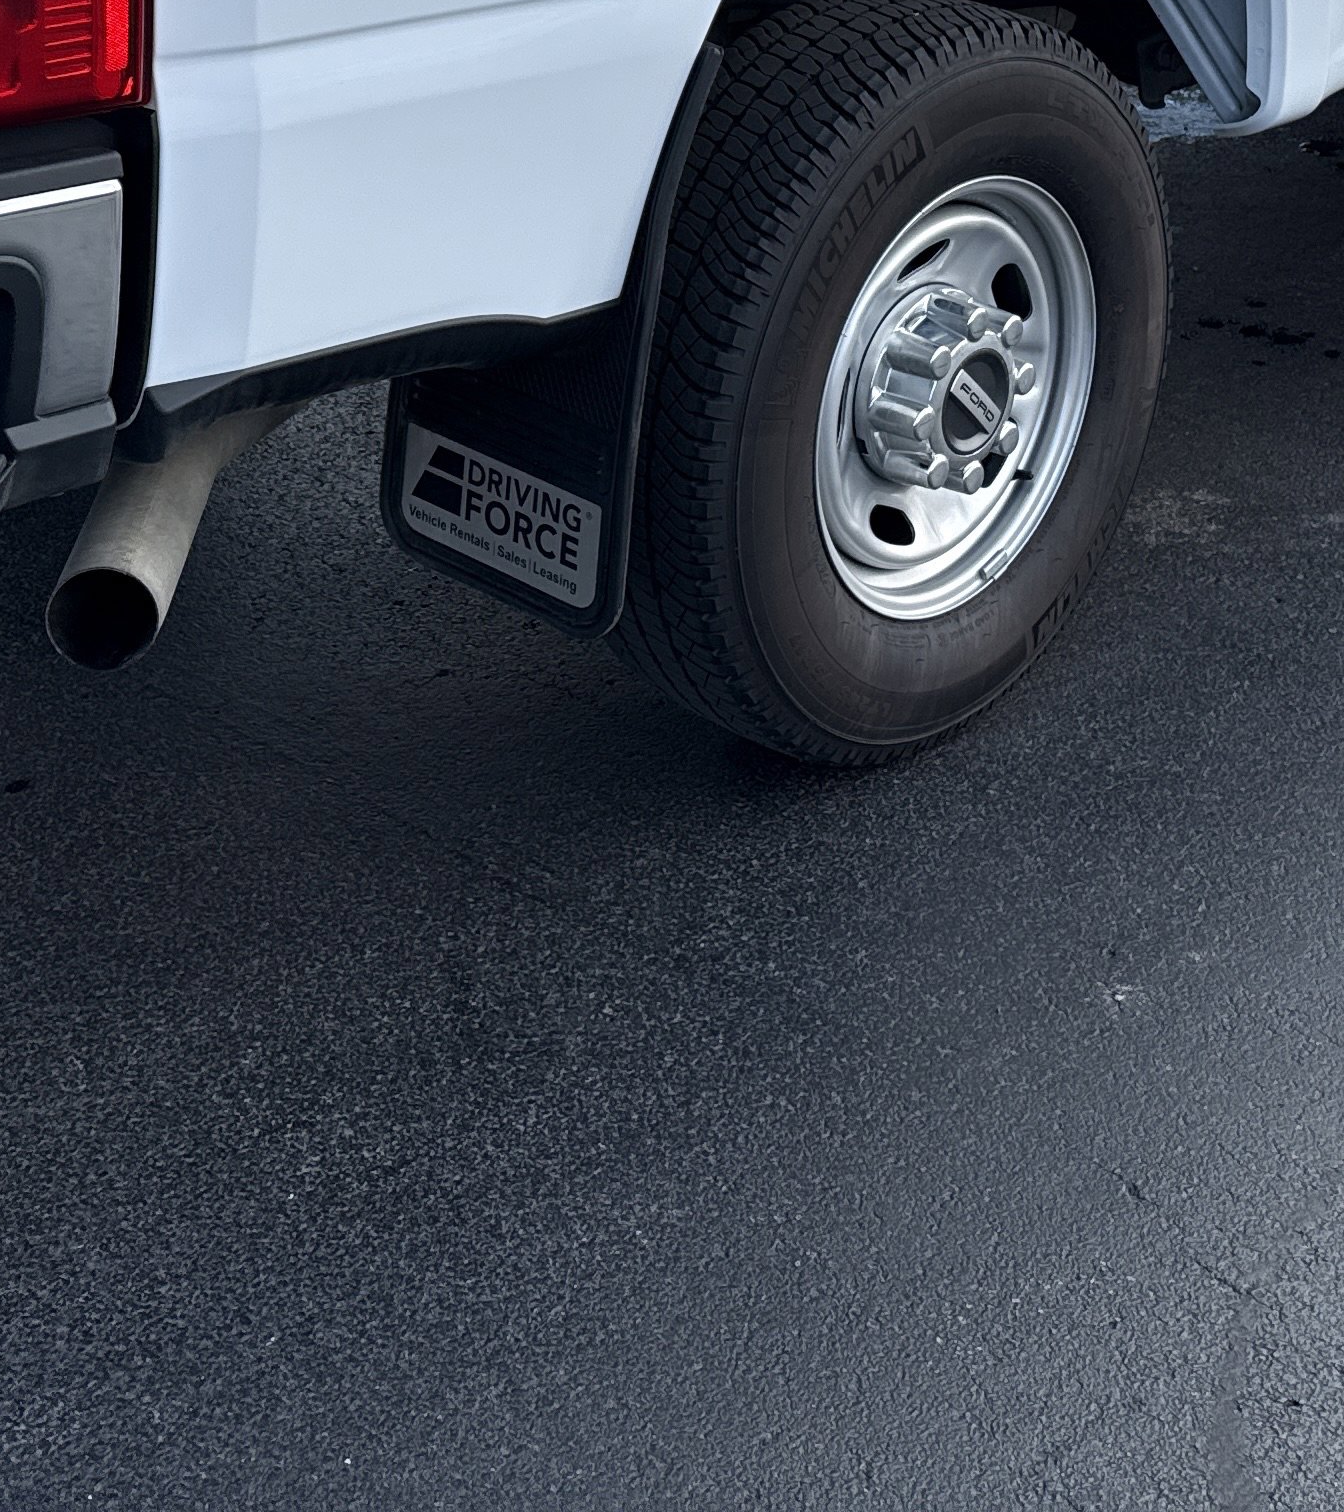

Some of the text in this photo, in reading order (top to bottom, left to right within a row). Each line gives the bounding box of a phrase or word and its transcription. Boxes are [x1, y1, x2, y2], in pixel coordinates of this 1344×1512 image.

[788, 125, 928, 342] MICHELIN
[959, 382, 995, 423] FORD
[464, 488, 580, 572] FORCE
[467, 458, 582, 533] DRIVING
[409, 504, 578, 596] Vehicle Rentals Sales Leasing
